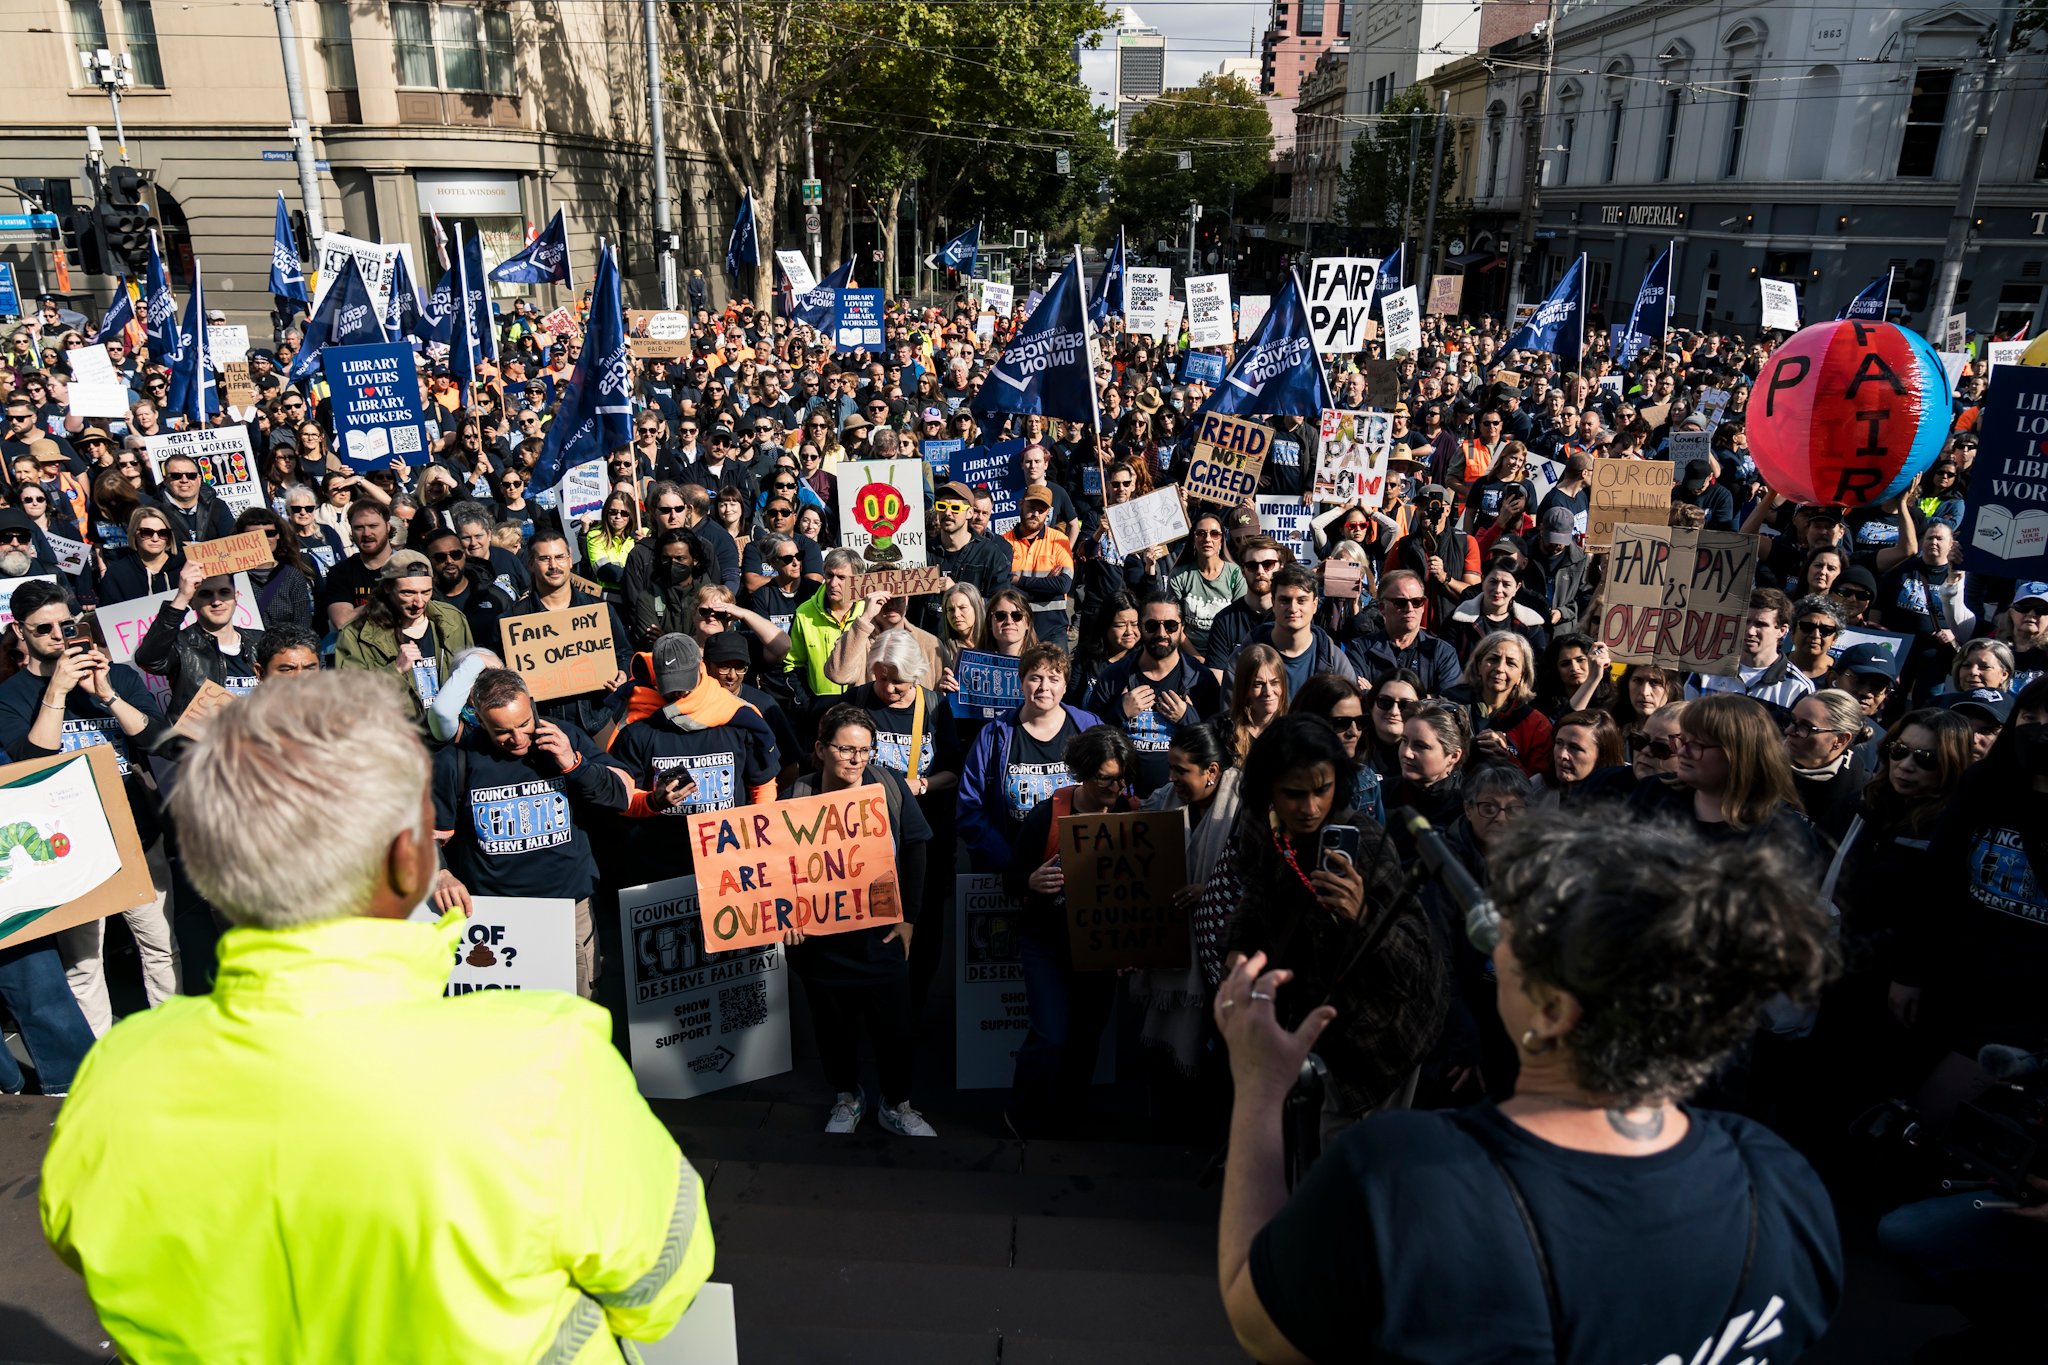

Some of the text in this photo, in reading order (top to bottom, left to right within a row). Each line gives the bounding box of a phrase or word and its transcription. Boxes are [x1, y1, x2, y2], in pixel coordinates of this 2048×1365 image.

[1818, 29, 1842, 39] 1863
[437, 188, 507, 196] HOTEL WINDSOR
[809, 219, 818, 227] 40
[1628, 206, 1678, 226] IMPERIAL
[356, 248, 382, 260] WORKERS
[1312, 263, 1375, 301] FAIR
[1192, 300, 1225, 308] WORKERS
[1311, 305, 1366, 346] PAY
[1994, 349, 2013, 357] SICK
[226, 363, 246, 373] ALL
[341, 357, 399, 373] LIBRARY
[233, 373, 249, 381] CAN
[347, 371, 400, 387] LOVERS
[348, 396, 406, 413] LIBRARY
[346, 409, 413, 426] WORKERS
[1201, 417, 1266, 455] READ
[1323, 411, 1388, 444] FAIR
[166, 430, 218, 445] MERRI-BEK
[1671, 443, 1708, 451] WORKERS
[1673, 433, 1710, 444] COUNCIL
[156, 439, 243, 459] COUNCIL WORKERS
[1211, 447, 1247, 469] NOT
[1324, 442, 1385, 469] PAY
[1671, 450, 1706, 459] DESERVE
[588, 464, 600, 472] pay
[962, 453, 1011, 472] LIBRARY
[1524, 463, 1538, 472] OF
[965, 467, 1009, 483] LOVERS
[1190, 460, 1256, 496] GREED
[1315, 469, 1383, 498] NOW
[1531, 473, 1538, 481] ?
[1597, 462, 1639, 487] OUR
[236, 484, 253, 495] PAY
[569, 486, 601, 496] inflation
[1260, 503, 1315, 516] VICTORIA.
[1596, 489, 1667, 512] OF LIVING
[1277, 517, 1297, 528] THE
[62, 542, 82, 551] ISN'T
[191, 533, 261, 559] FAIR WORK
[843, 531, 923, 547] THE VERY
[2015, 537, 2046, 545] SUPPORT
[202, 549, 268, 576] FAIR PAY!!!
[218, 551, 232, 561] for
[850, 571, 896, 588] FAIR
[901, 565, 935, 580] PAY
[1613, 539, 1750, 603] FAIR PAY
[850, 577, 938, 601] NO DELAY
[1664, 577, 1687, 608] is
[508, 610, 599, 647] FAIR PAY
[1604, 604, 1742, 661] OVERDUE!
[514, 635, 613, 673] IS OVERDUE
[963, 653, 993, 665] COUNCIL
[961, 693, 1016, 706] DESERVE FAIR
[1152, 740, 1170, 750] FAIR
[654, 754, 733, 770] COUNCIL WORKERS
[1008, 765, 1044, 775] COUNCIL
[474, 777, 565, 804] COUNCIL WORKERS
[695, 798, 733, 814] FAIR PAY
[697, 796, 888, 858] FAIR WAGES
[480, 831, 570, 854] DESERVE FAIR PAY
[1071, 820, 1154, 854] FAIR
[718, 844, 865, 897] ARE LONG
[1096, 853, 1155, 881] PAY
[1095, 880, 1152, 904] FOR
[633, 895, 700, 925] COUNCIL
[713, 888, 865, 941] OVERDUE!
[1075, 904, 1186, 928] COUNCIL
[468, 924, 506, 946] OF
[1088, 925, 1169, 951] STAFF
[500, 946, 518, 968] ?
[639, 952, 775, 1001] DESERVE FAIR PAY
[674, 998, 710, 1017] SHOW
[679, 1011, 712, 1029] YOUR
[655, 1024, 713, 1049] SUPPORT
[687, 1052, 725, 1069] SERVICES
[692, 1060, 720, 1073] UNION
